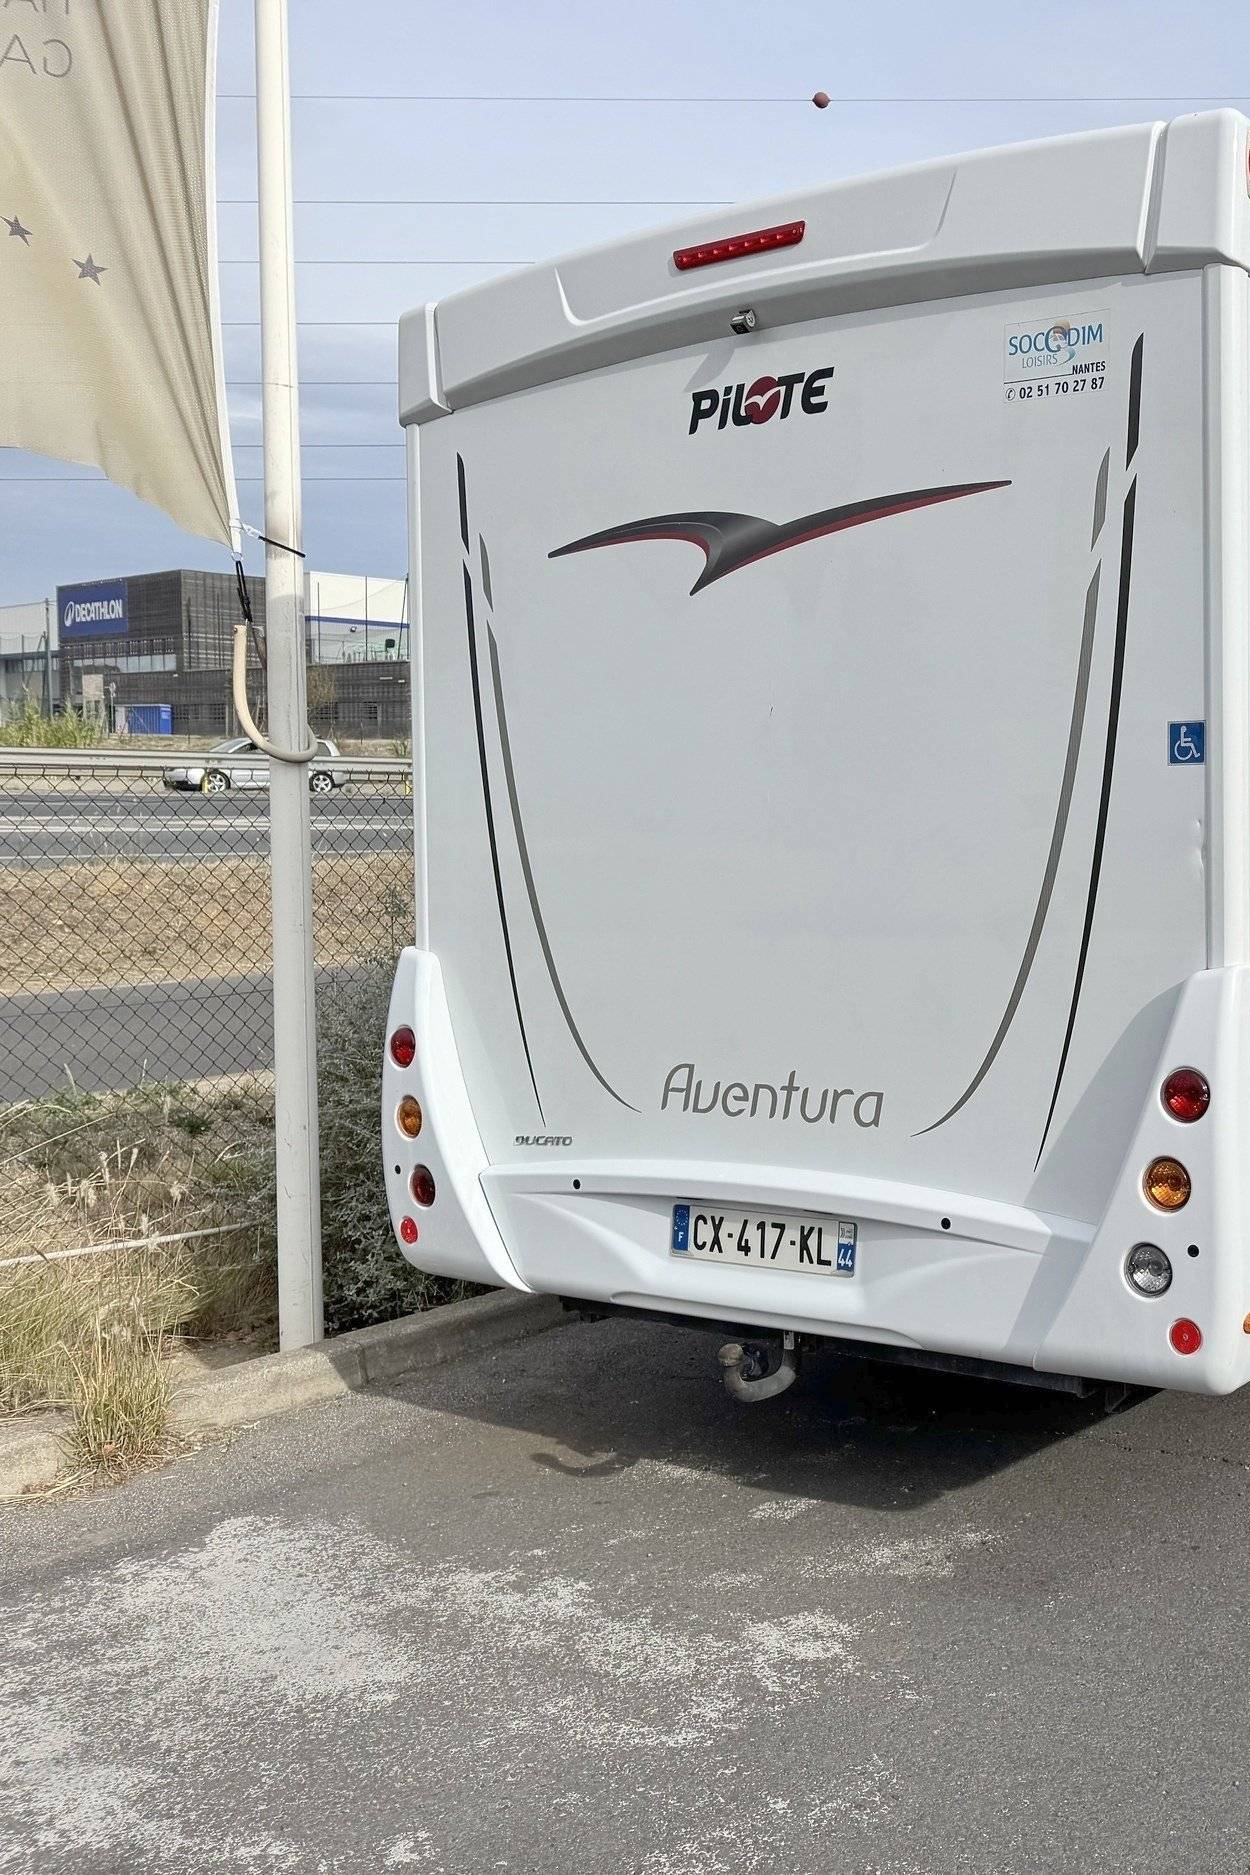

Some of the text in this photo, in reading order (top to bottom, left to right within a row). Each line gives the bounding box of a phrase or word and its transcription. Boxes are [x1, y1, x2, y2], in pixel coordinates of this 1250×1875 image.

[1072, 360, 1106, 375] NANTES
[1019, 376, 1105, 400] 02 51 70 27 87
[75, 598, 123, 623] DECATHLON
[661, 1062, 885, 1129] Aventura
[514, 1135, 573, 1147] DUCATO
[678, 1231, 685, 1243] F
[693, 1214, 832, 1267] CX-417-KL
[838, 1249, 853, 1268] 44
